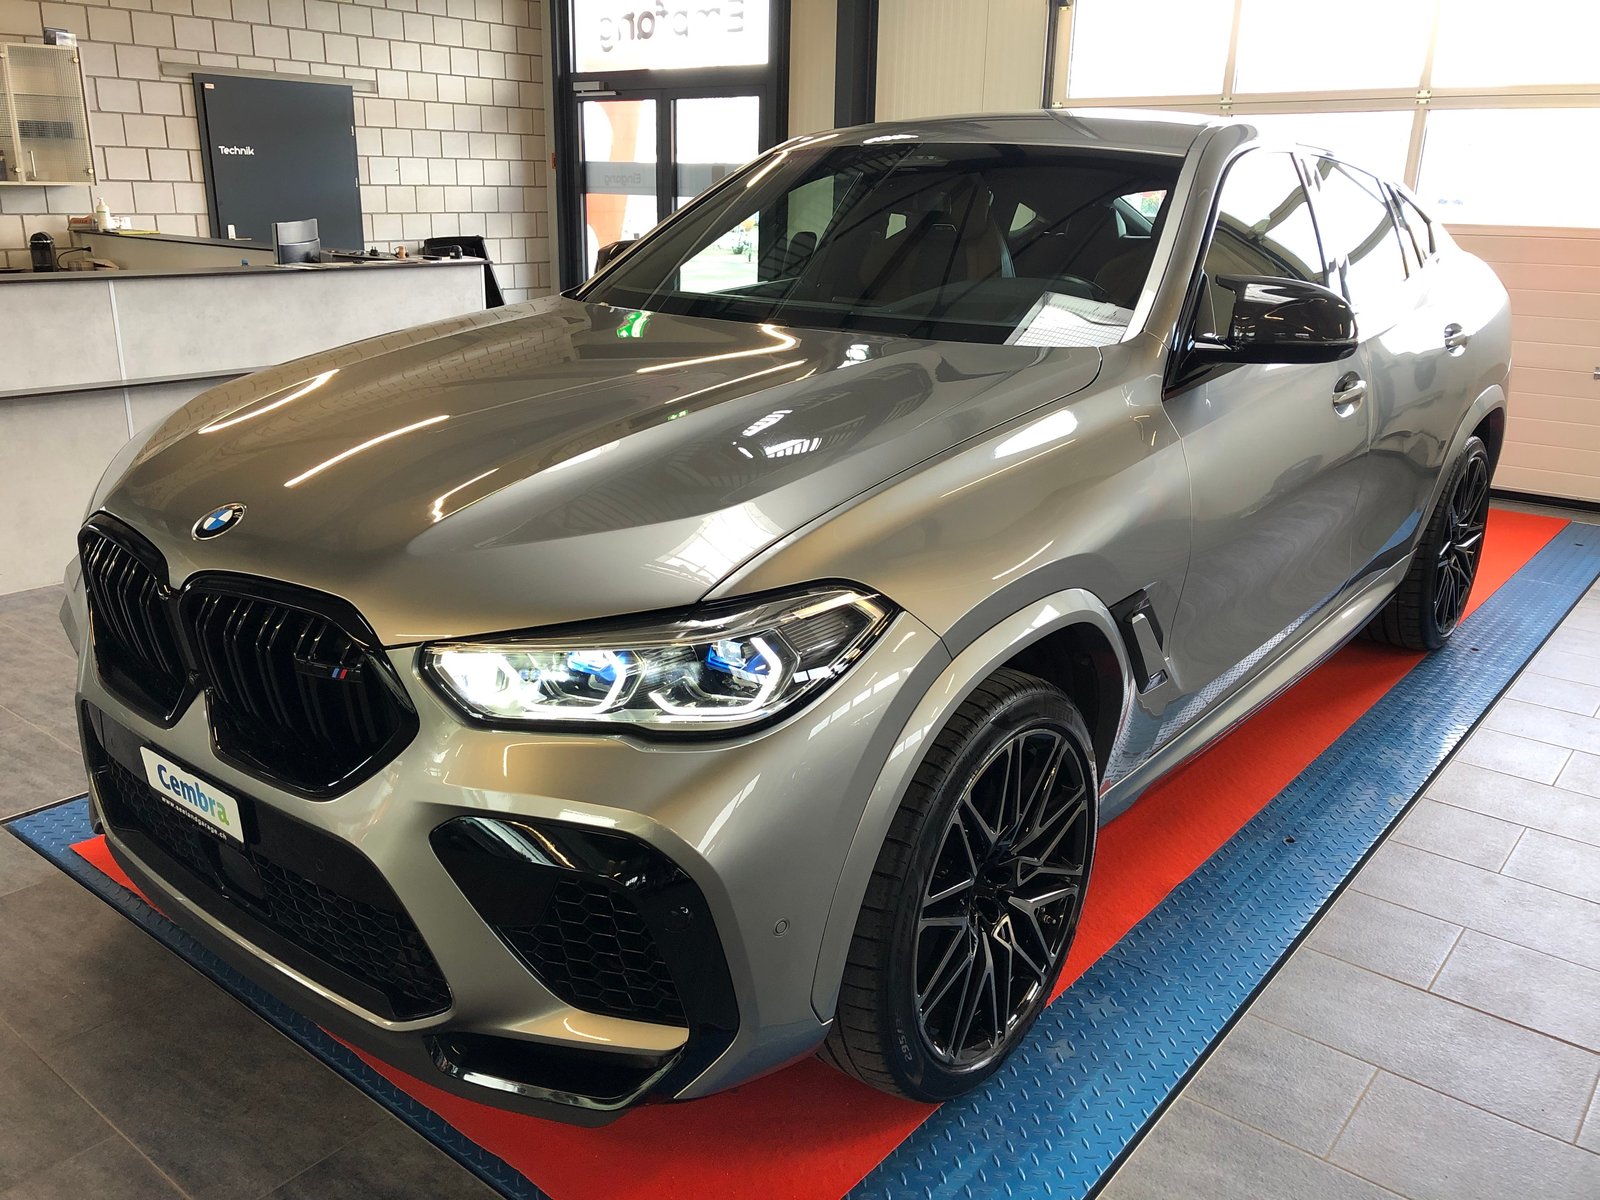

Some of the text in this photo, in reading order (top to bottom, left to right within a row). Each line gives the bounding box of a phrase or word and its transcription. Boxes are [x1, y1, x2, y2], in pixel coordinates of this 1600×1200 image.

[218, 145, 255, 156] Technik
[157, 763, 230, 826] Cembra
[161, 796, 227, 840] www.seelandgarage.ch
